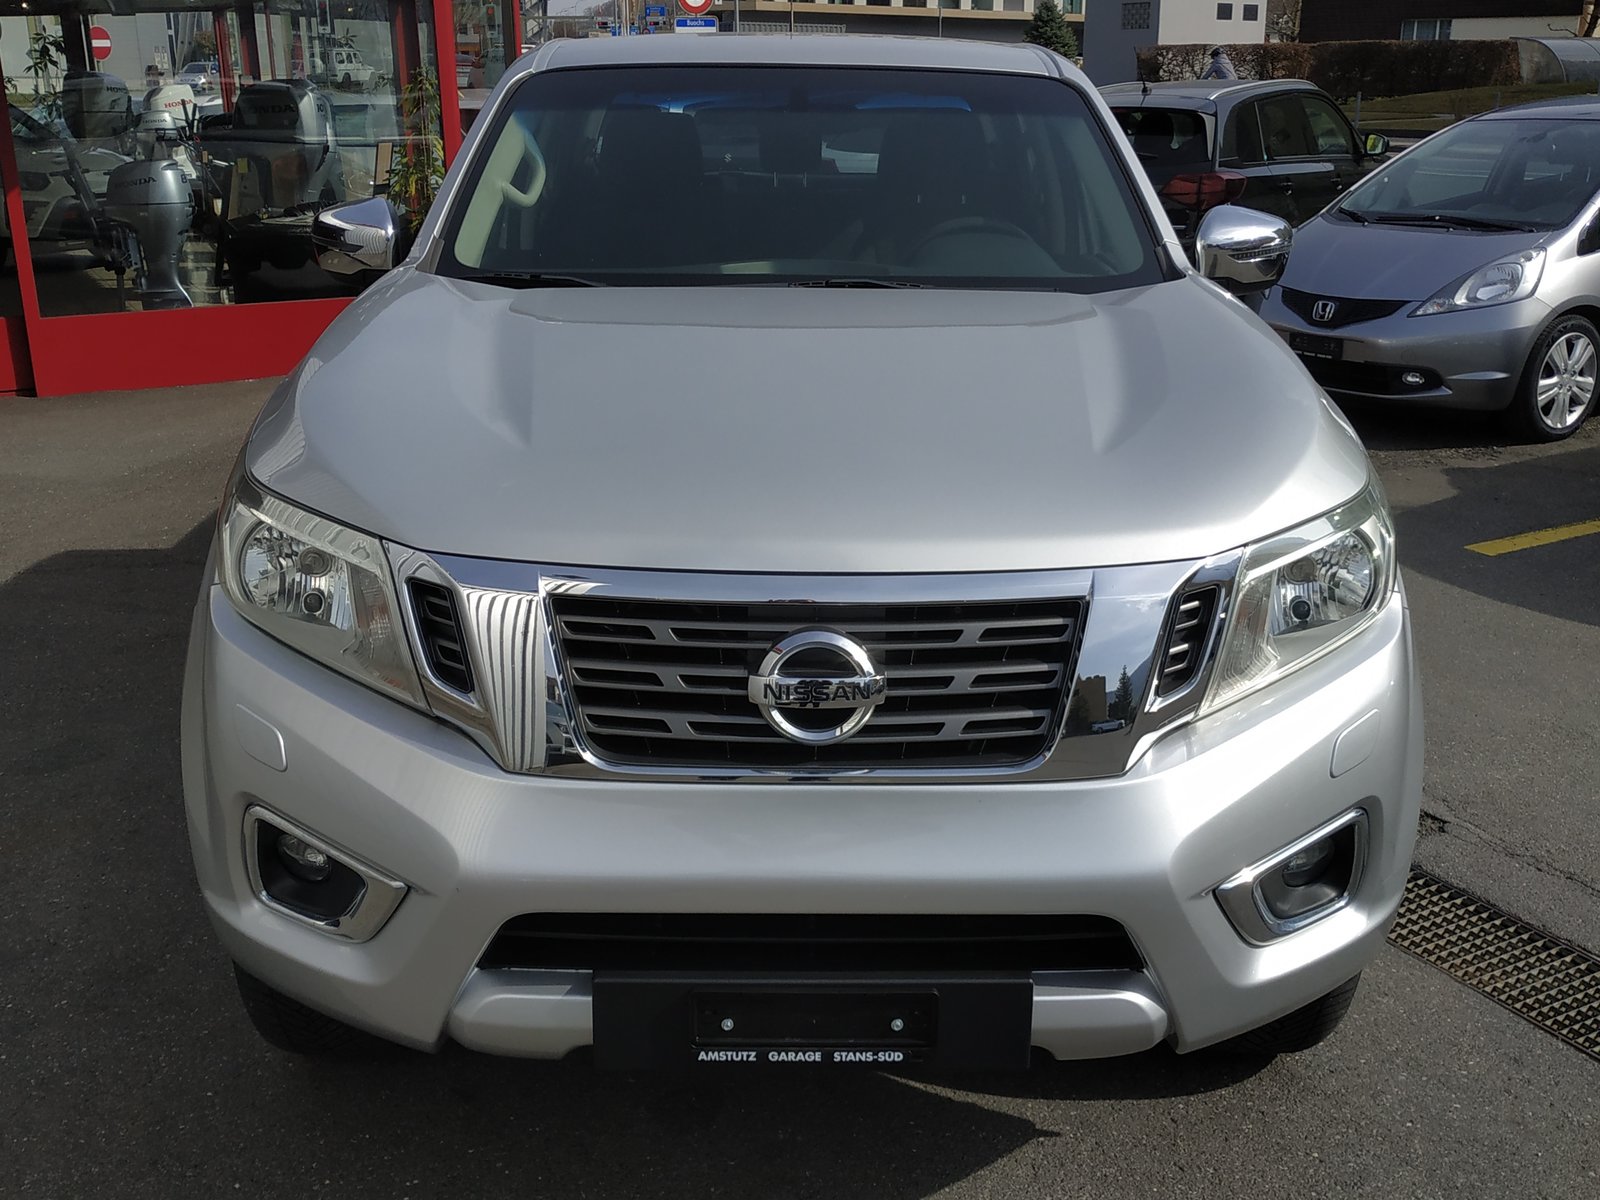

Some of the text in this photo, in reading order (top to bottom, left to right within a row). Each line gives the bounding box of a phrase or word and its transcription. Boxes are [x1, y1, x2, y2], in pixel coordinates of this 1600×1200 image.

[687, 18, 705, 26] Buochs
[763, 683, 871, 702] NISSAN
[698, 1050, 903, 1062] AMSTUTZ GARAGE STANS-SÜD
